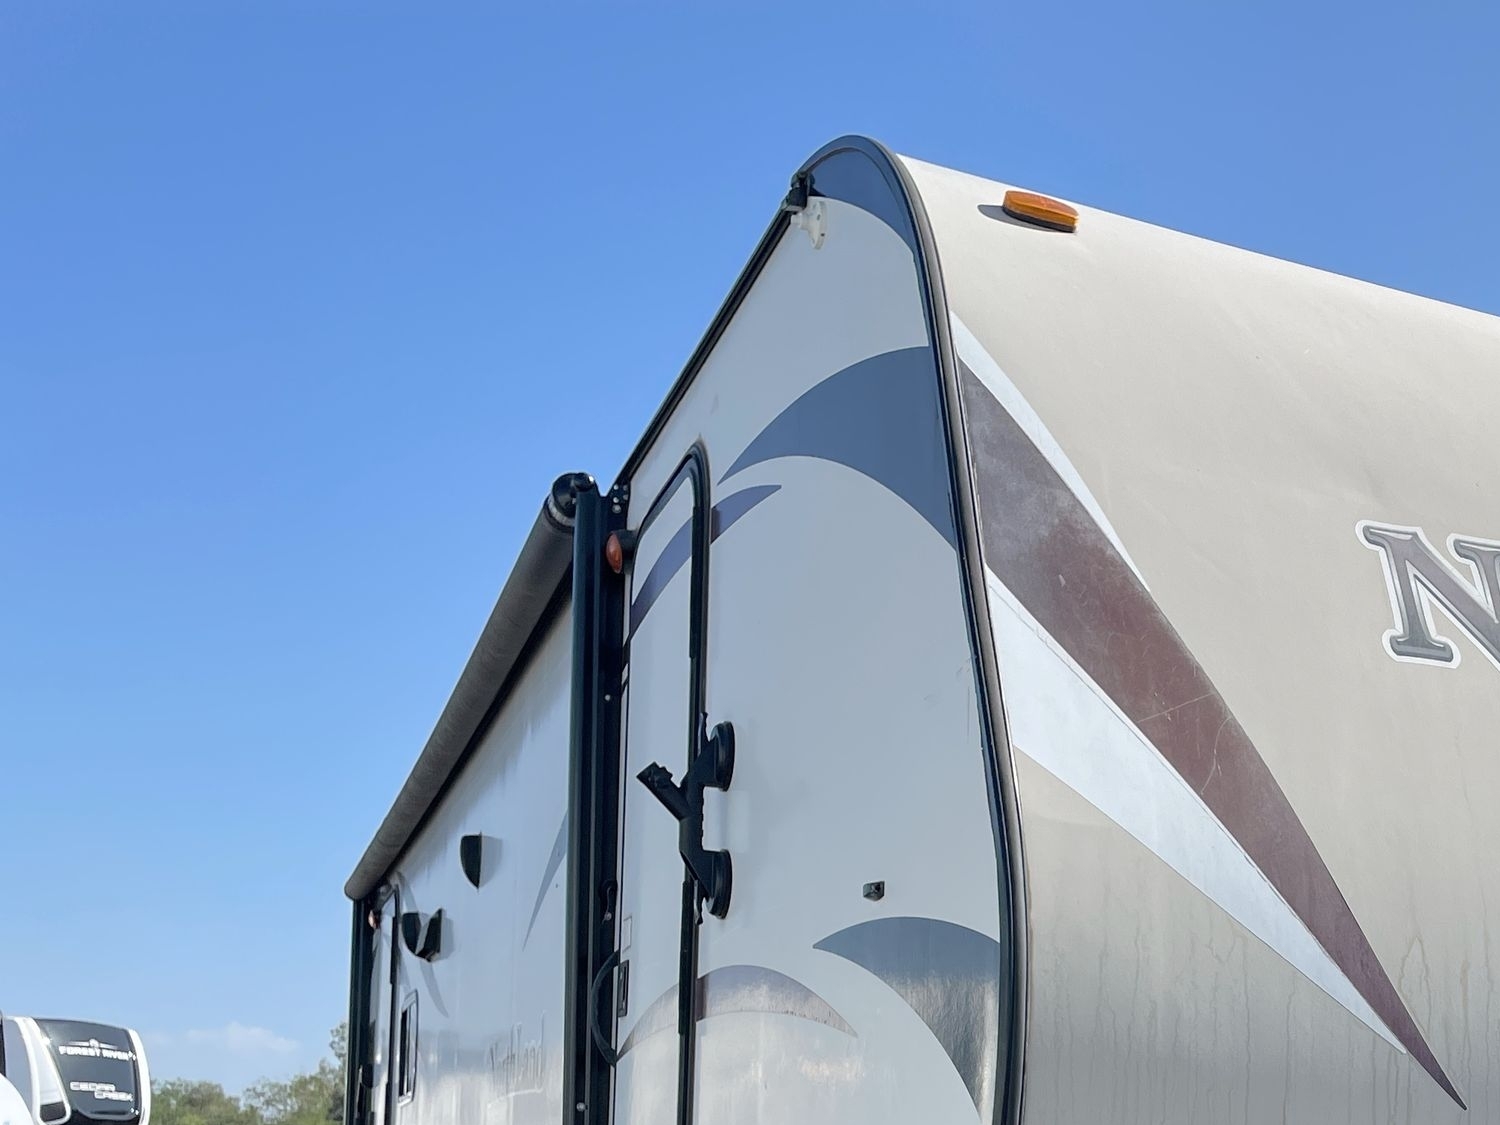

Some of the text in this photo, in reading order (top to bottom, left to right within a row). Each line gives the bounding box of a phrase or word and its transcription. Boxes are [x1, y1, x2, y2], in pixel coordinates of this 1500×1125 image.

[58, 1045, 101, 1057] FOREST
[70, 1081, 115, 1092] CEDAR
[94, 1091, 133, 1102] CREEK
